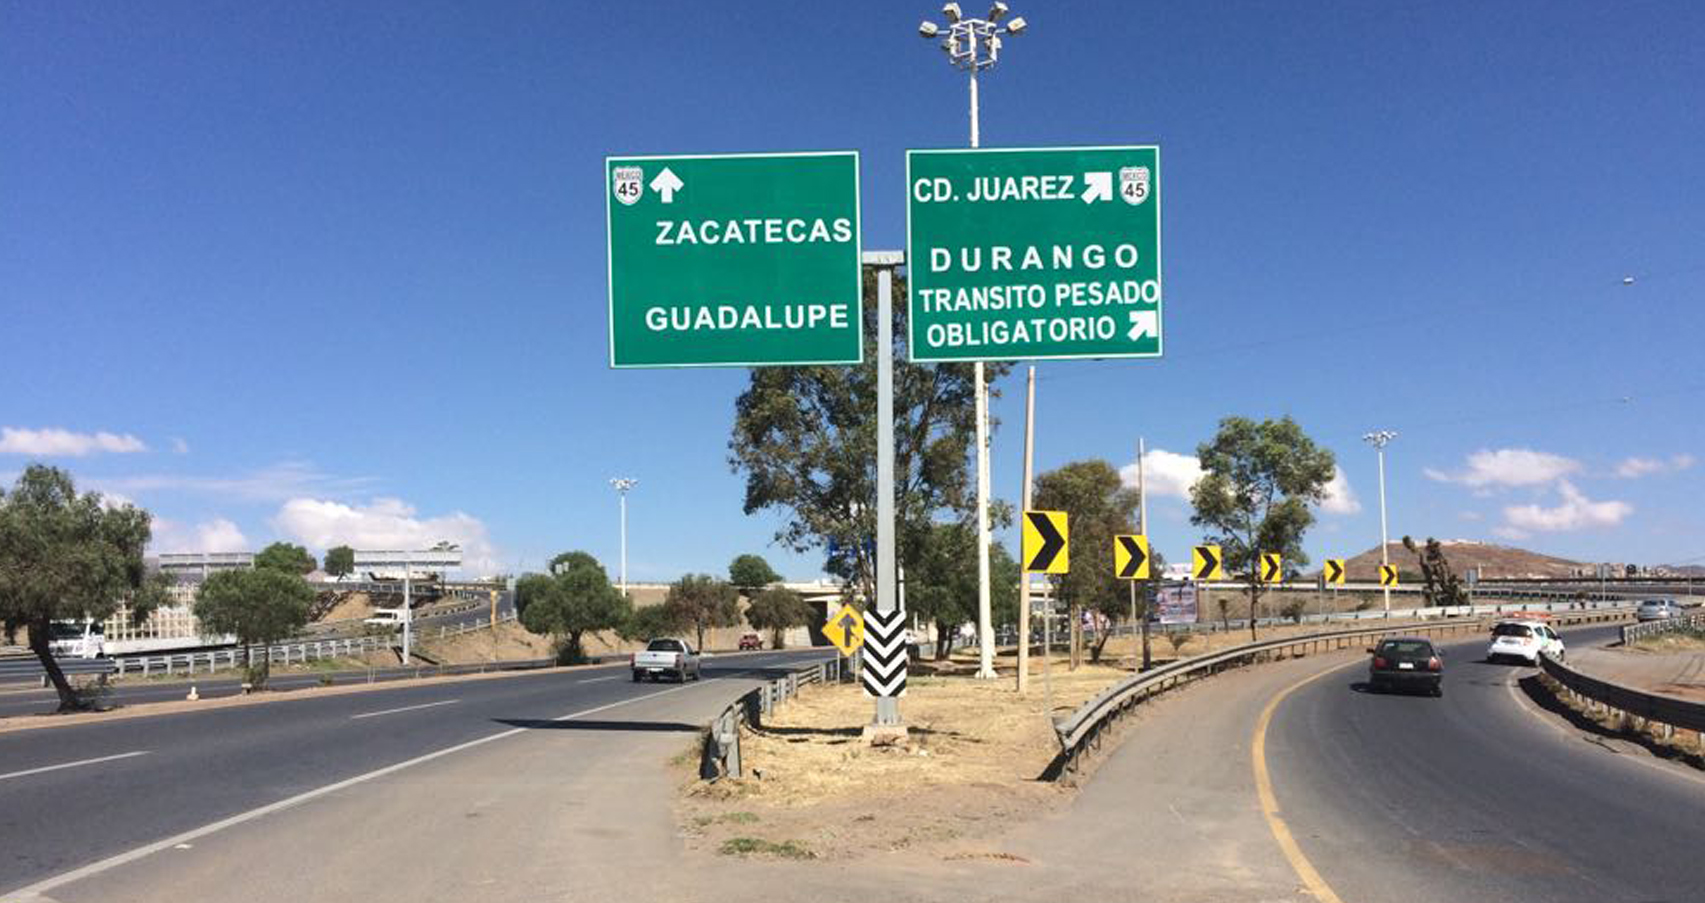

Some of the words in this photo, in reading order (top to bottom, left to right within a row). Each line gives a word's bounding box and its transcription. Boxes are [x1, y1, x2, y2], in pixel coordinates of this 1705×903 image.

[618, 182, 639, 197] 45
[914, 178, 959, 202] CD.
[967, 176, 1075, 201] JUAREZ
[1124, 182, 1145, 197] 45
[655, 218, 852, 245] ZACATECAS
[931, 244, 1138, 272] DURANGO
[918, 285, 1046, 312] TRANSITO
[1056, 280, 1160, 306] PESADO
[645, 304, 848, 331] GUADALUPE
[927, 316, 1116, 347] OBLIGATORIO
